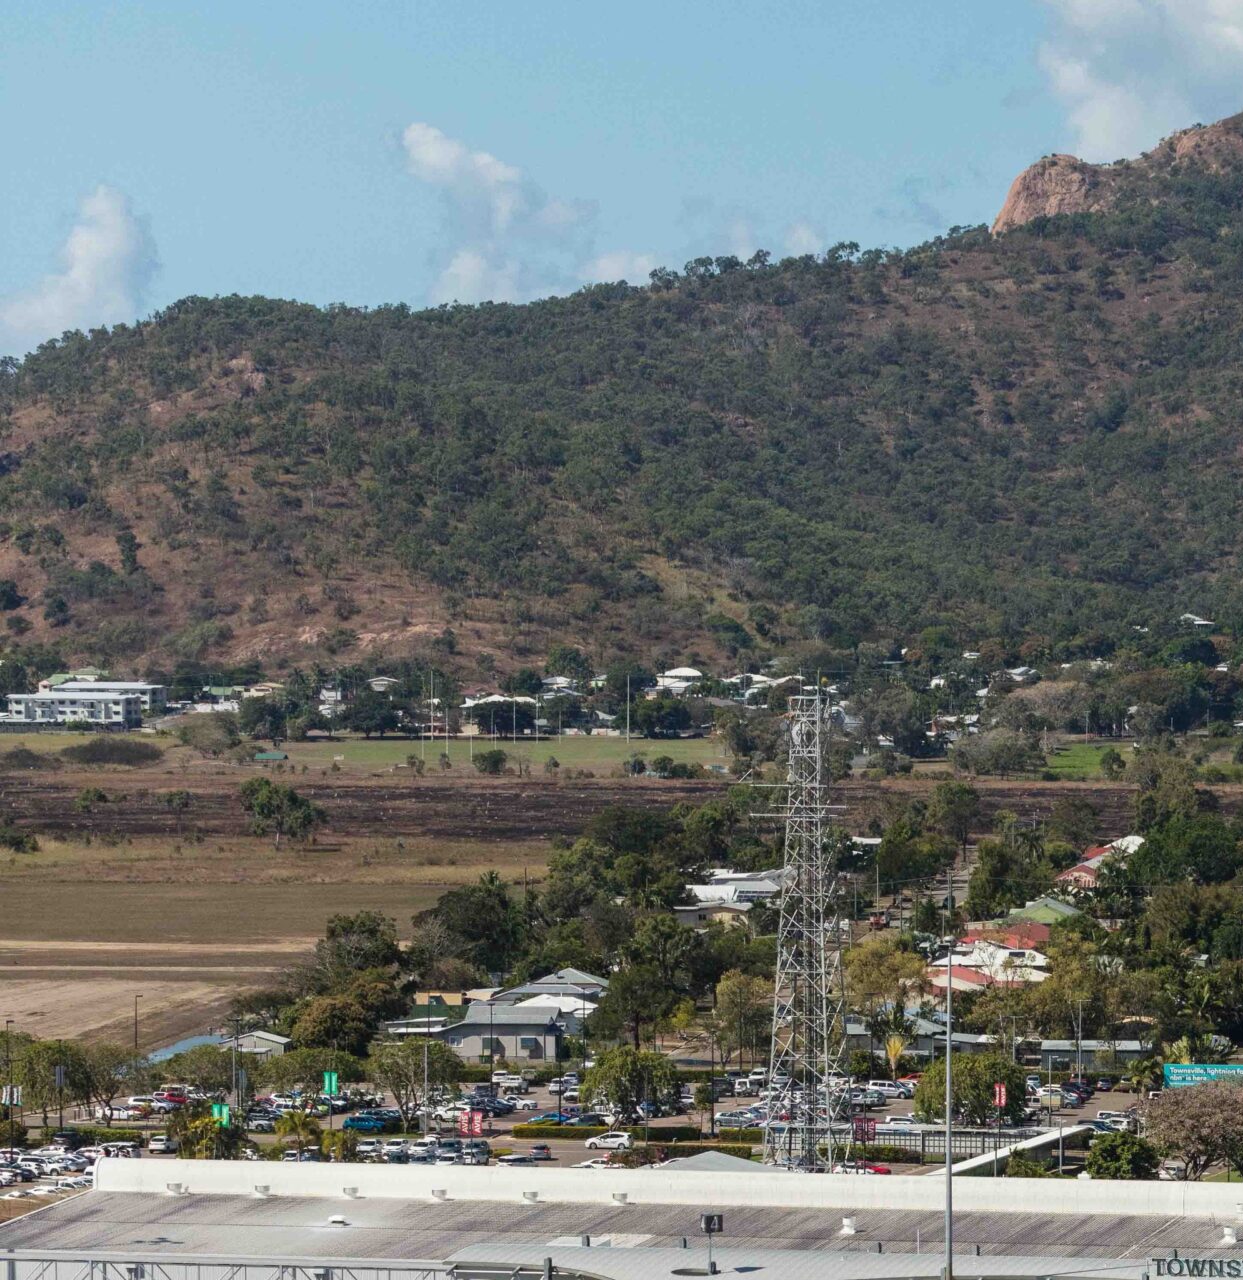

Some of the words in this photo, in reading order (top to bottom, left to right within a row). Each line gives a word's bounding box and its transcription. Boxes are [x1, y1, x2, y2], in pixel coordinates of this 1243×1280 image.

[1170, 1067, 1206, 1075] Townsville,
[1206, 1067, 1236, 1076] lightning
[710, 1216, 718, 1232] 4
